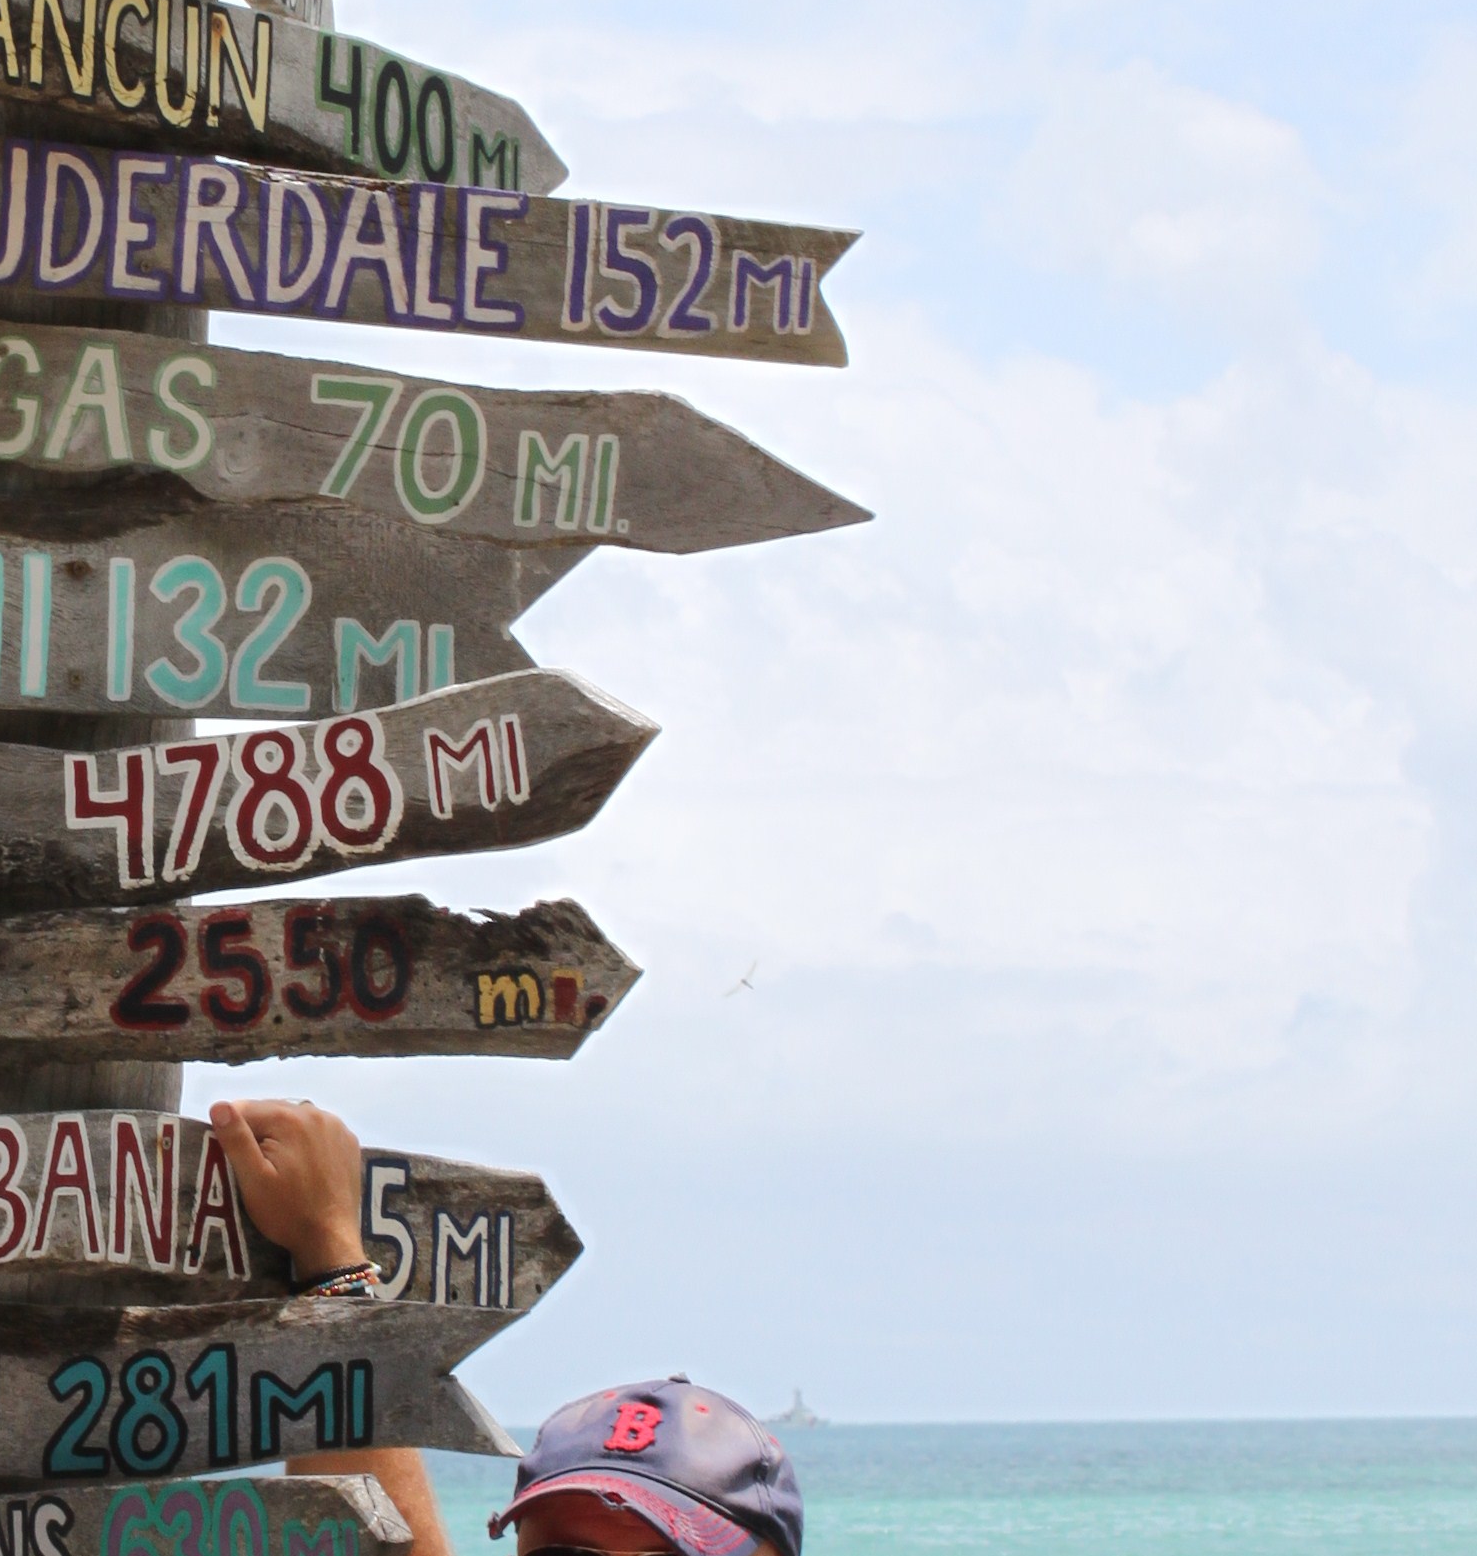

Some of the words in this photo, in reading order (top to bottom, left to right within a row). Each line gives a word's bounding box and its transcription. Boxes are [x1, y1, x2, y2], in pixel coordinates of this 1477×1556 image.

[315, 34, 455, 185] 400
[469, 132, 520, 193] MI
[563, 200, 718, 338] 152
[729, 249, 818, 336] MI
[310, 372, 484, 525] 70
[515, 428, 632, 534] MI.
[107, 554, 312, 711] 132
[334, 617, 455, 713] MI
[64, 709, 407, 889] 4788
[424, 713, 529, 819] MI
[110, 903, 413, 1032] 2550
[362, 1156, 416, 1301] 5
[431, 1207, 514, 1309] MI
[47, 1345, 237, 1477] 281
[251, 1359, 373, 1460] MI
[604, 1402, 663, 1452] B
